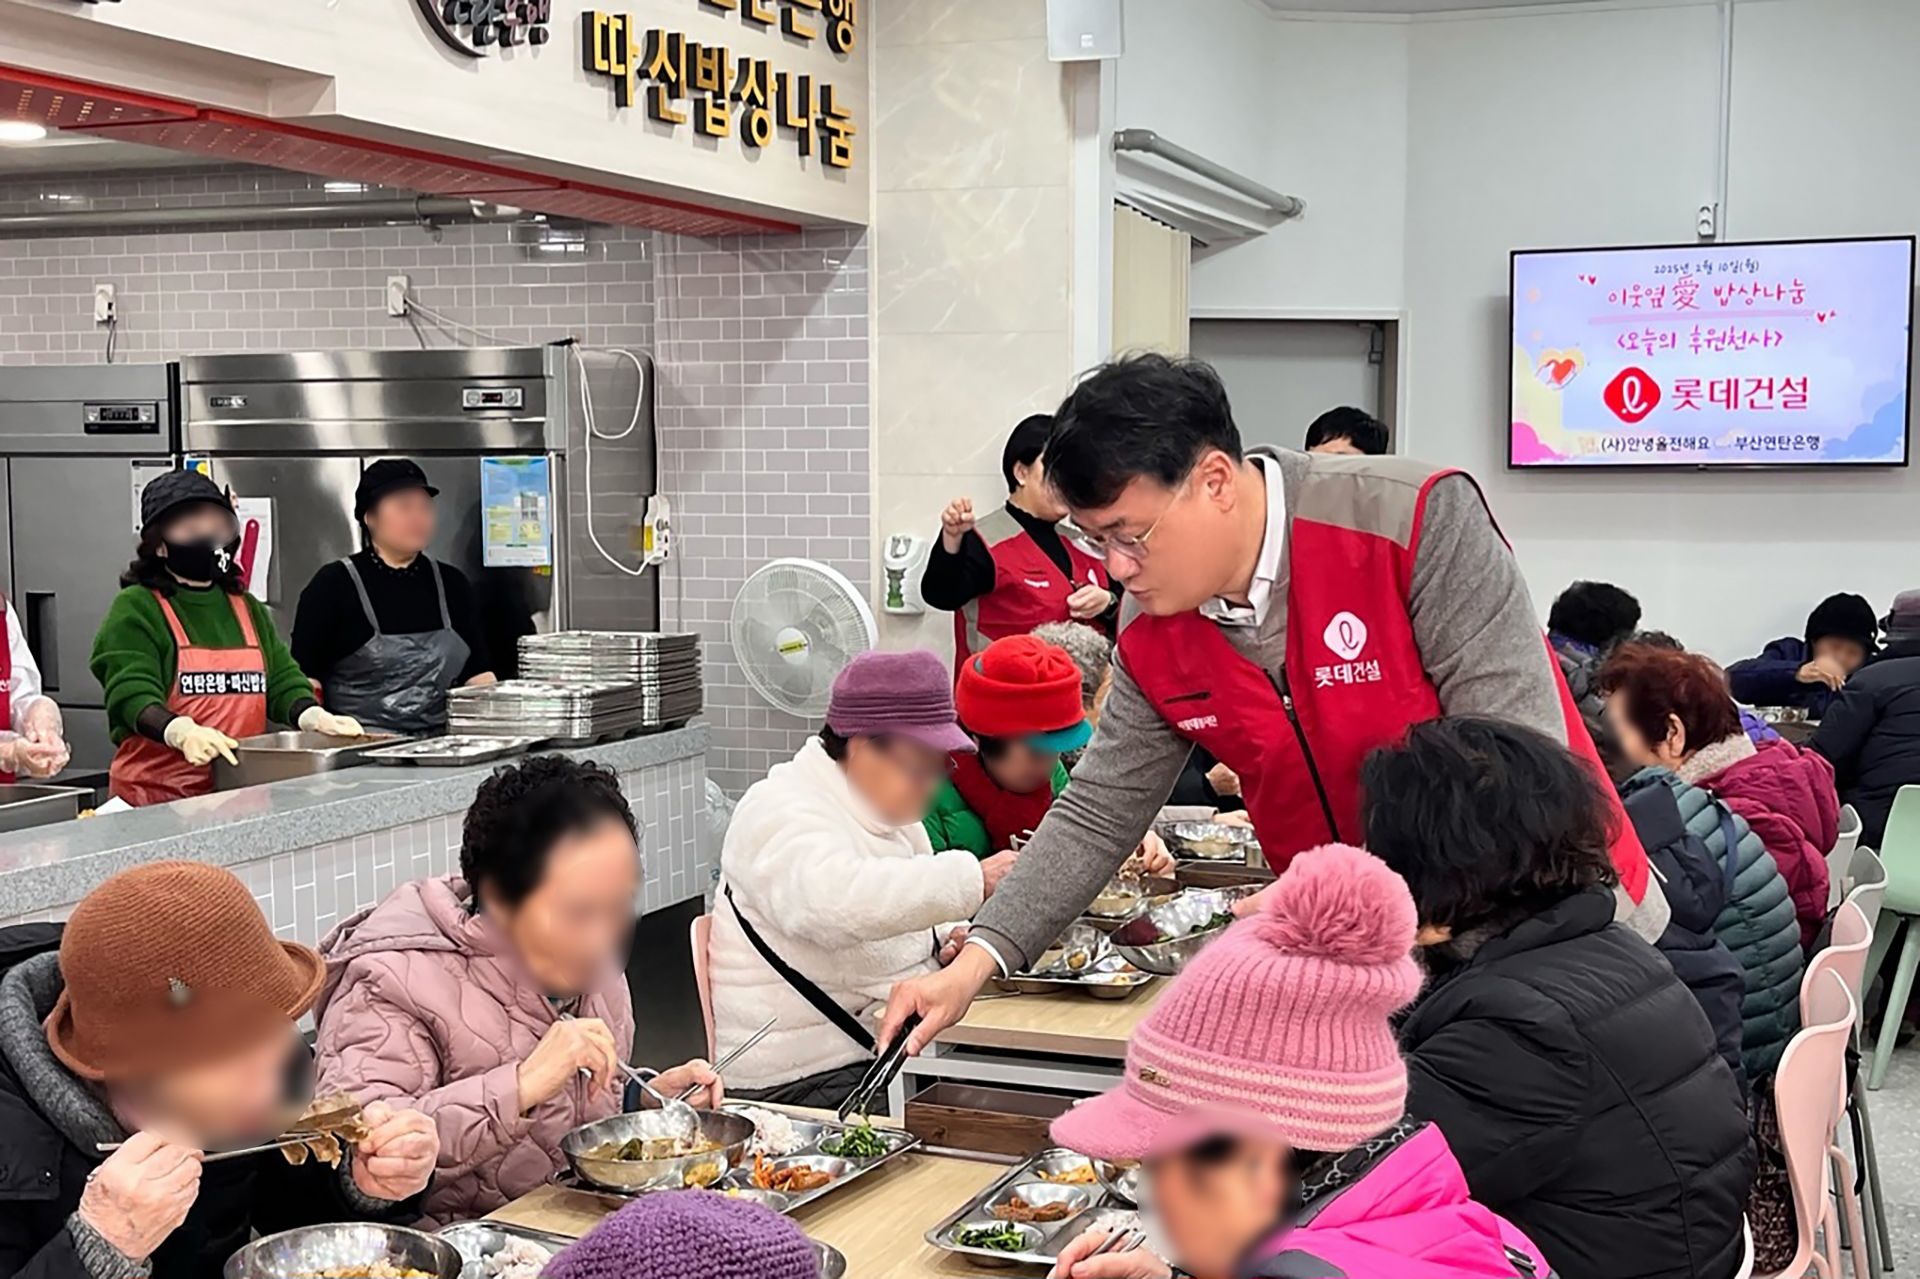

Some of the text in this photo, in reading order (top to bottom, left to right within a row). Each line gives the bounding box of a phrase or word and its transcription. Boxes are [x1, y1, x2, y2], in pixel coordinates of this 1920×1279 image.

[1696, 259, 1714, 275] 2월
[1713, 278, 1806, 307] 밥상나눔
[1671, 376, 1809, 411] 롯데건설
[1735, 434, 1821, 450] 부산연탄은행
[1314, 659, 1382, 688] 롯데건설
